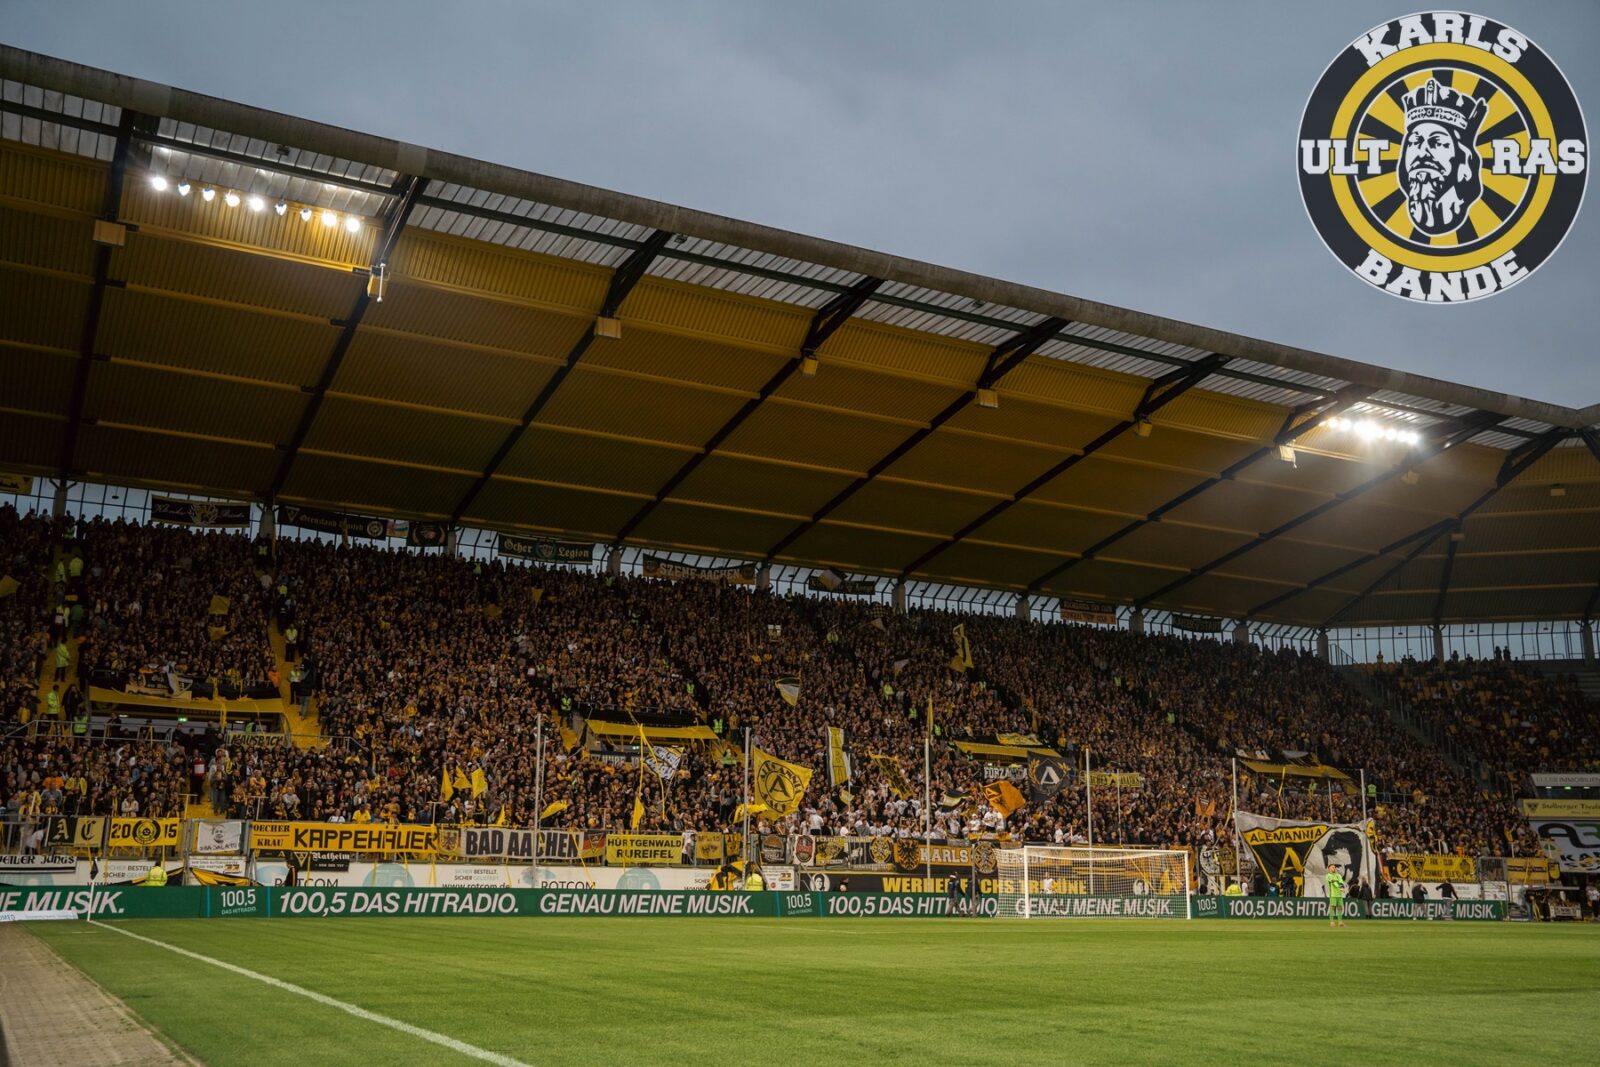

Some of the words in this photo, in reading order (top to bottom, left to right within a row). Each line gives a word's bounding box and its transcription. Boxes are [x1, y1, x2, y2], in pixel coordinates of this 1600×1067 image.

[253, 824, 290, 833] OECHER
[1250, 828, 1322, 843] ALEMANNIA
[294, 825, 437, 850] KAPPEHÄUER
[466, 830, 504, 856] BAD
[507, 831, 580, 858] AACHEN
[607, 836, 682, 848] HÜRTGENWALD
[0, 855, 35, 865] EILER
[616, 848, 674, 859] RUREIFEL
[920, 847, 969, 864] KARLS
[274, 878, 339, 887] RTCOM
[960, 878, 1015, 894] FCHS
[24, 891, 125, 914] MUSIK.
[280, 891, 348, 917] 100,5
[350, 892, 400, 914] DAS
[403, 891, 519, 914] HITRADIO.
[540, 892, 616, 914] GENAU
[618, 893, 684, 914] MEINE
[687, 894, 754, 915] MUSIK.
[828, 895, 875, 918] 100,5
[879, 896, 914, 915] DAS
[918, 896, 999, 916] HITRAIO.
[1072, 898, 1122, 916] MEINE
[1123, 899, 1174, 916] MUSIK.
[1229, 899, 1265, 919] 100,5
[1267, 900, 1294, 917] DAS
[1371, 902, 1415, 918] GENAU
[1456, 903, 1497, 919] MUSIK.
